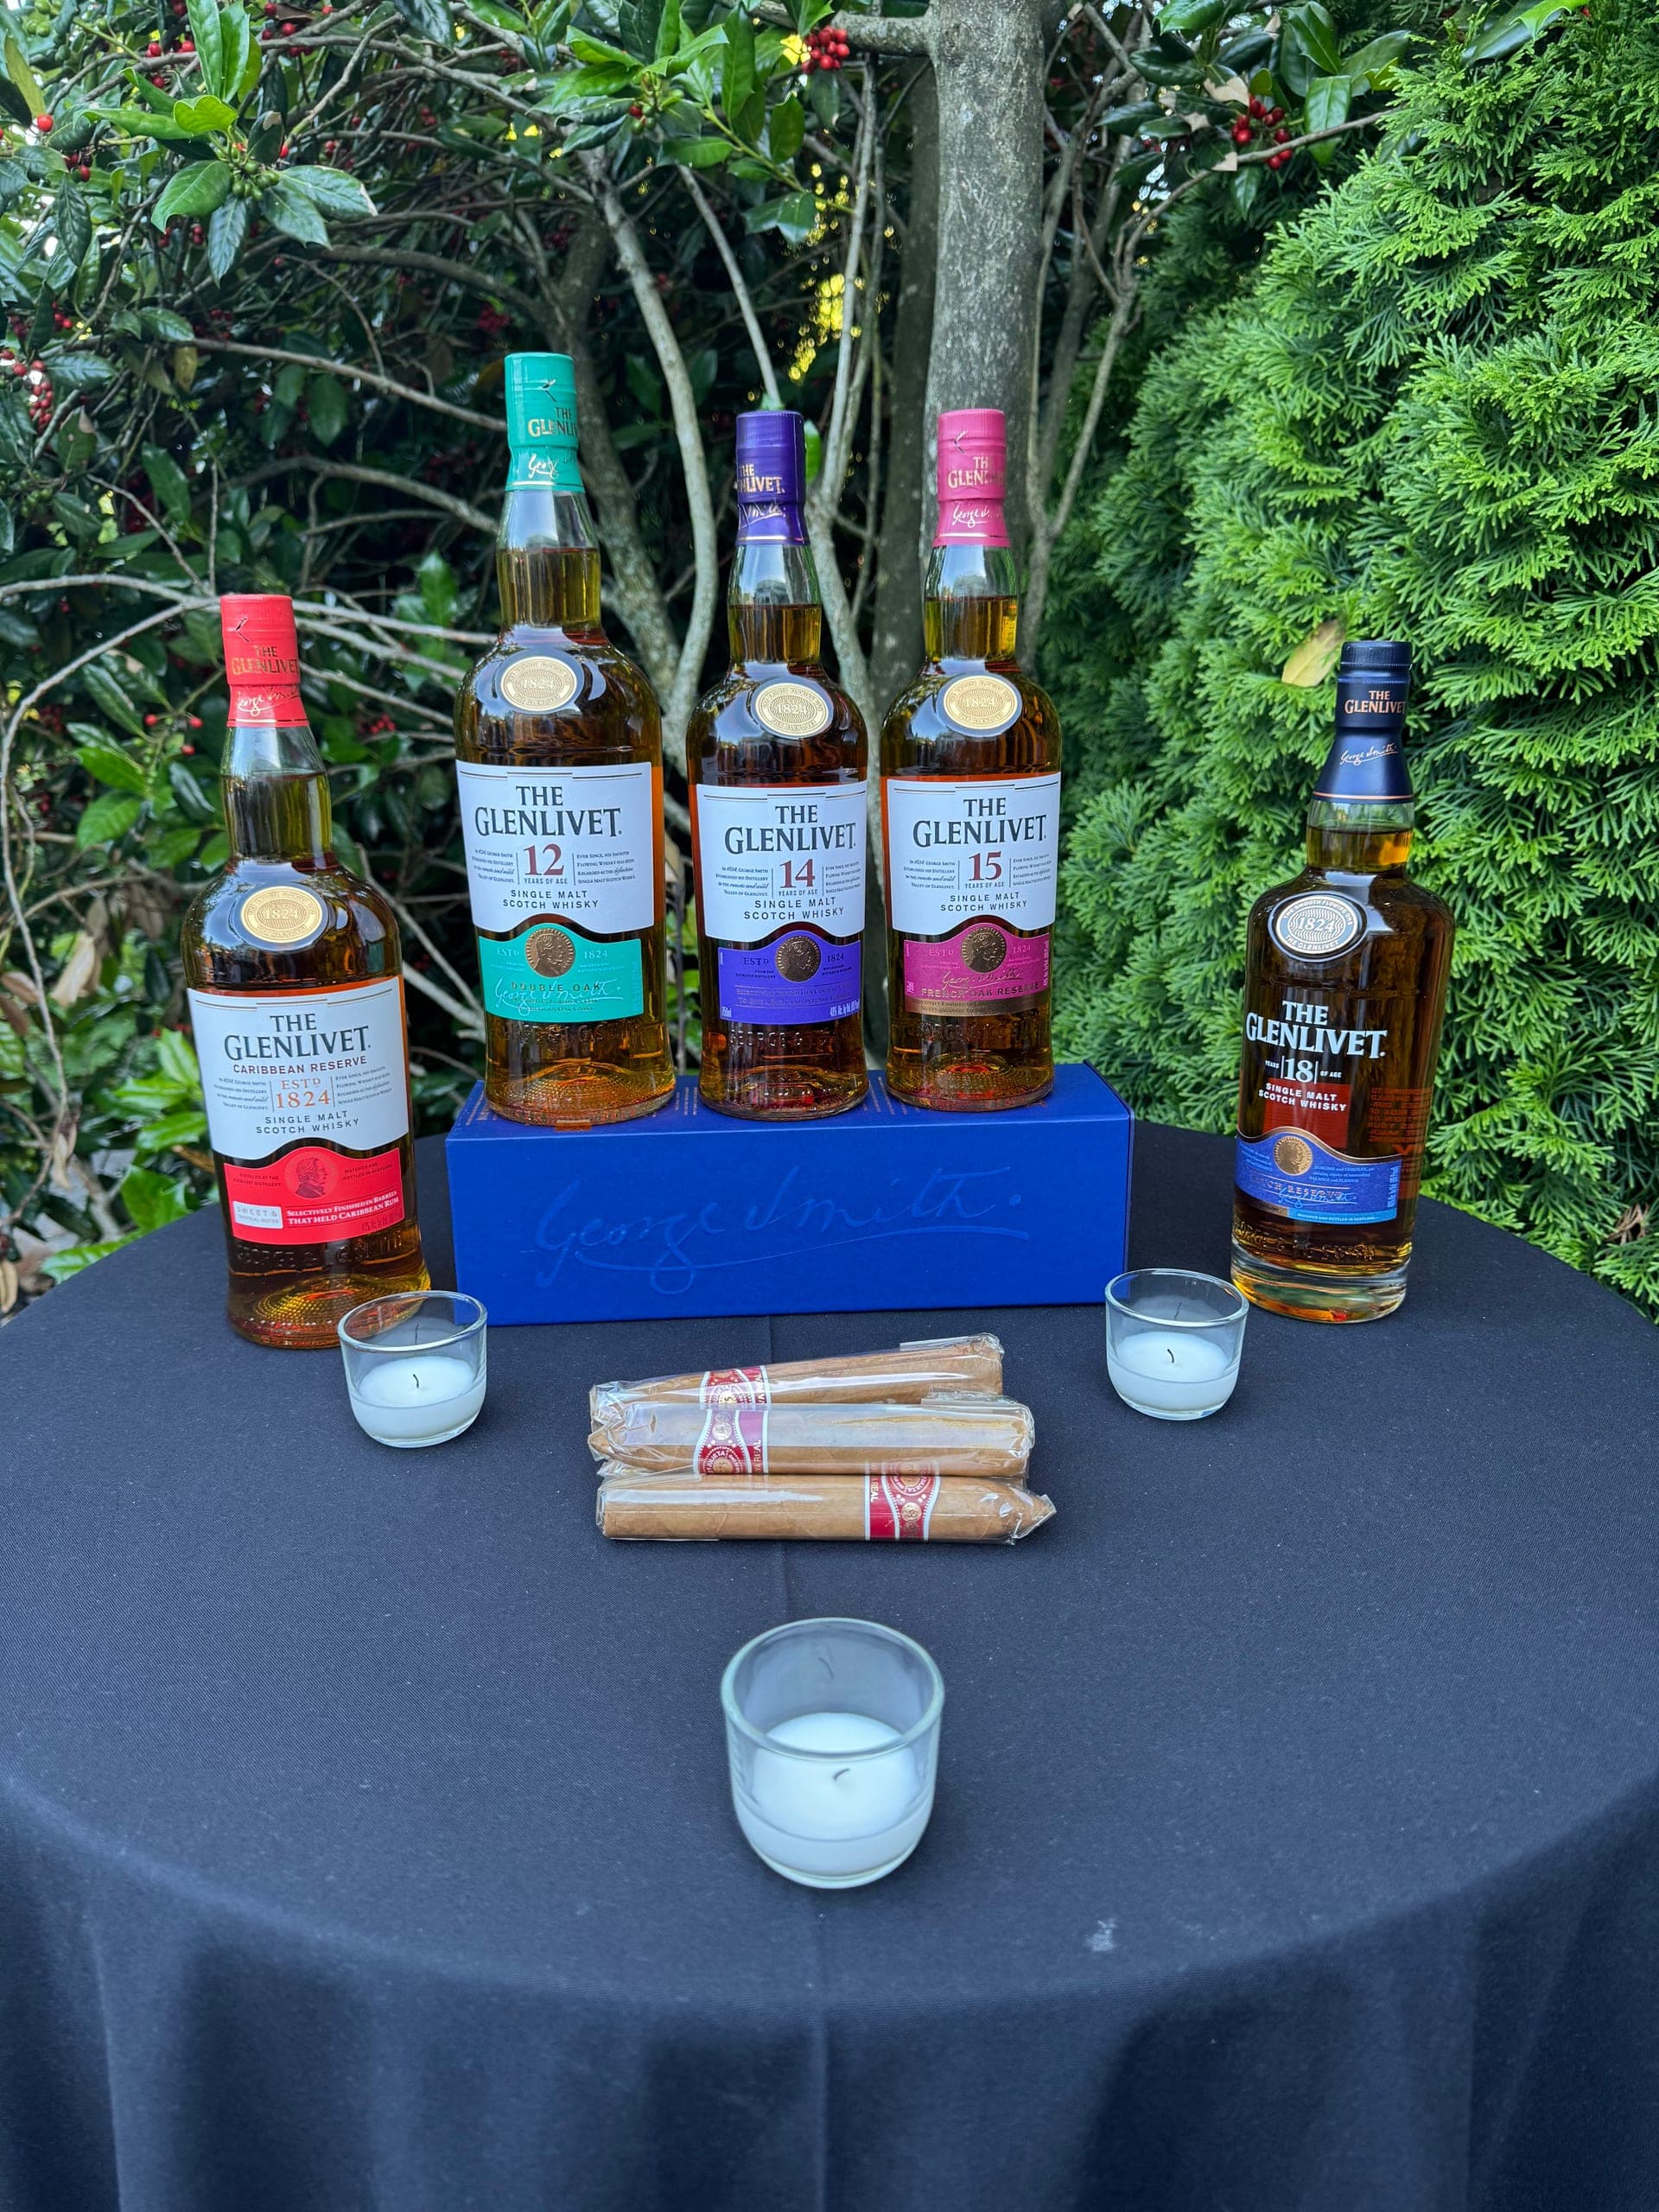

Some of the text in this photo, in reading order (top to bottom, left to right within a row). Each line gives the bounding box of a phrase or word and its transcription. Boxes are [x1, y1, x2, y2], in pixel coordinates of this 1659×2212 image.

[254, 645, 277, 658] THE
[231, 657, 298, 676] GLENLIVET
[523, 678, 556, 690] 1824
[965, 697, 995, 708] 1824
[1369, 690, 1390, 701] THE
[777, 702, 808, 715] 1824
[1344, 700, 1407, 715] GLENLIVET
[516, 785, 564, 806] THE
[774, 804, 818, 824] THE
[963, 797, 1007, 817] THE
[523, 843, 565, 877] 12
[968, 851, 1002, 881] 15
[779, 858, 816, 889] 14
[511, 889, 588, 899] SINGLE MALT
[995, 892, 1020, 901] MALT
[503, 899, 599, 909] SCOTCH WHISKY
[754, 897, 836, 908] SINGLE MALT
[990, 900, 1027, 911] WHISKY
[265, 908, 299, 919] 1824
[744, 906, 844, 920] SCOTCH WHISKY
[1298, 918, 1335, 933] 1824
[1298, 940, 1339, 950] GLENLIVET
[584, 949, 607, 959] 1824
[743, 952, 844, 965] ESTD 1824
[512, 982, 601, 992] DOUBLE OAK
[921, 988, 967, 999] FRENCH
[997, 982, 1039, 995] RESERVE
[1281, 1000, 1329, 1026] THE
[270, 1013, 317, 1033] THE
[233, 1055, 366, 1075] CARIBBEAN RESERVE
[1265, 1059, 1280, 1069] YEARS
[1284, 1058, 1313, 1084] 18
[282, 1077, 321, 1090] ESTD
[276, 1089, 331, 1109] 1824
[1265, 1082, 1338, 1102] SINGLE MALT
[1258, 1089, 1347, 1112] SCOTCH WHISKY
[264, 1110, 347, 1124] SINGLE MALT
[256, 1118, 359, 1135] SCOTCH WHISKY
[287, 1208, 333, 1217] SELECTIVELY
[334, 1201, 365, 1212] FINISHED
[373, 1191, 397, 1204] BARRELS
[314, 1214, 337, 1224] HELD
[339, 1204, 384, 1220] CARIBBEAN
[384, 1196, 399, 1208] RUM
[870, 1482, 880, 1503] REAL
